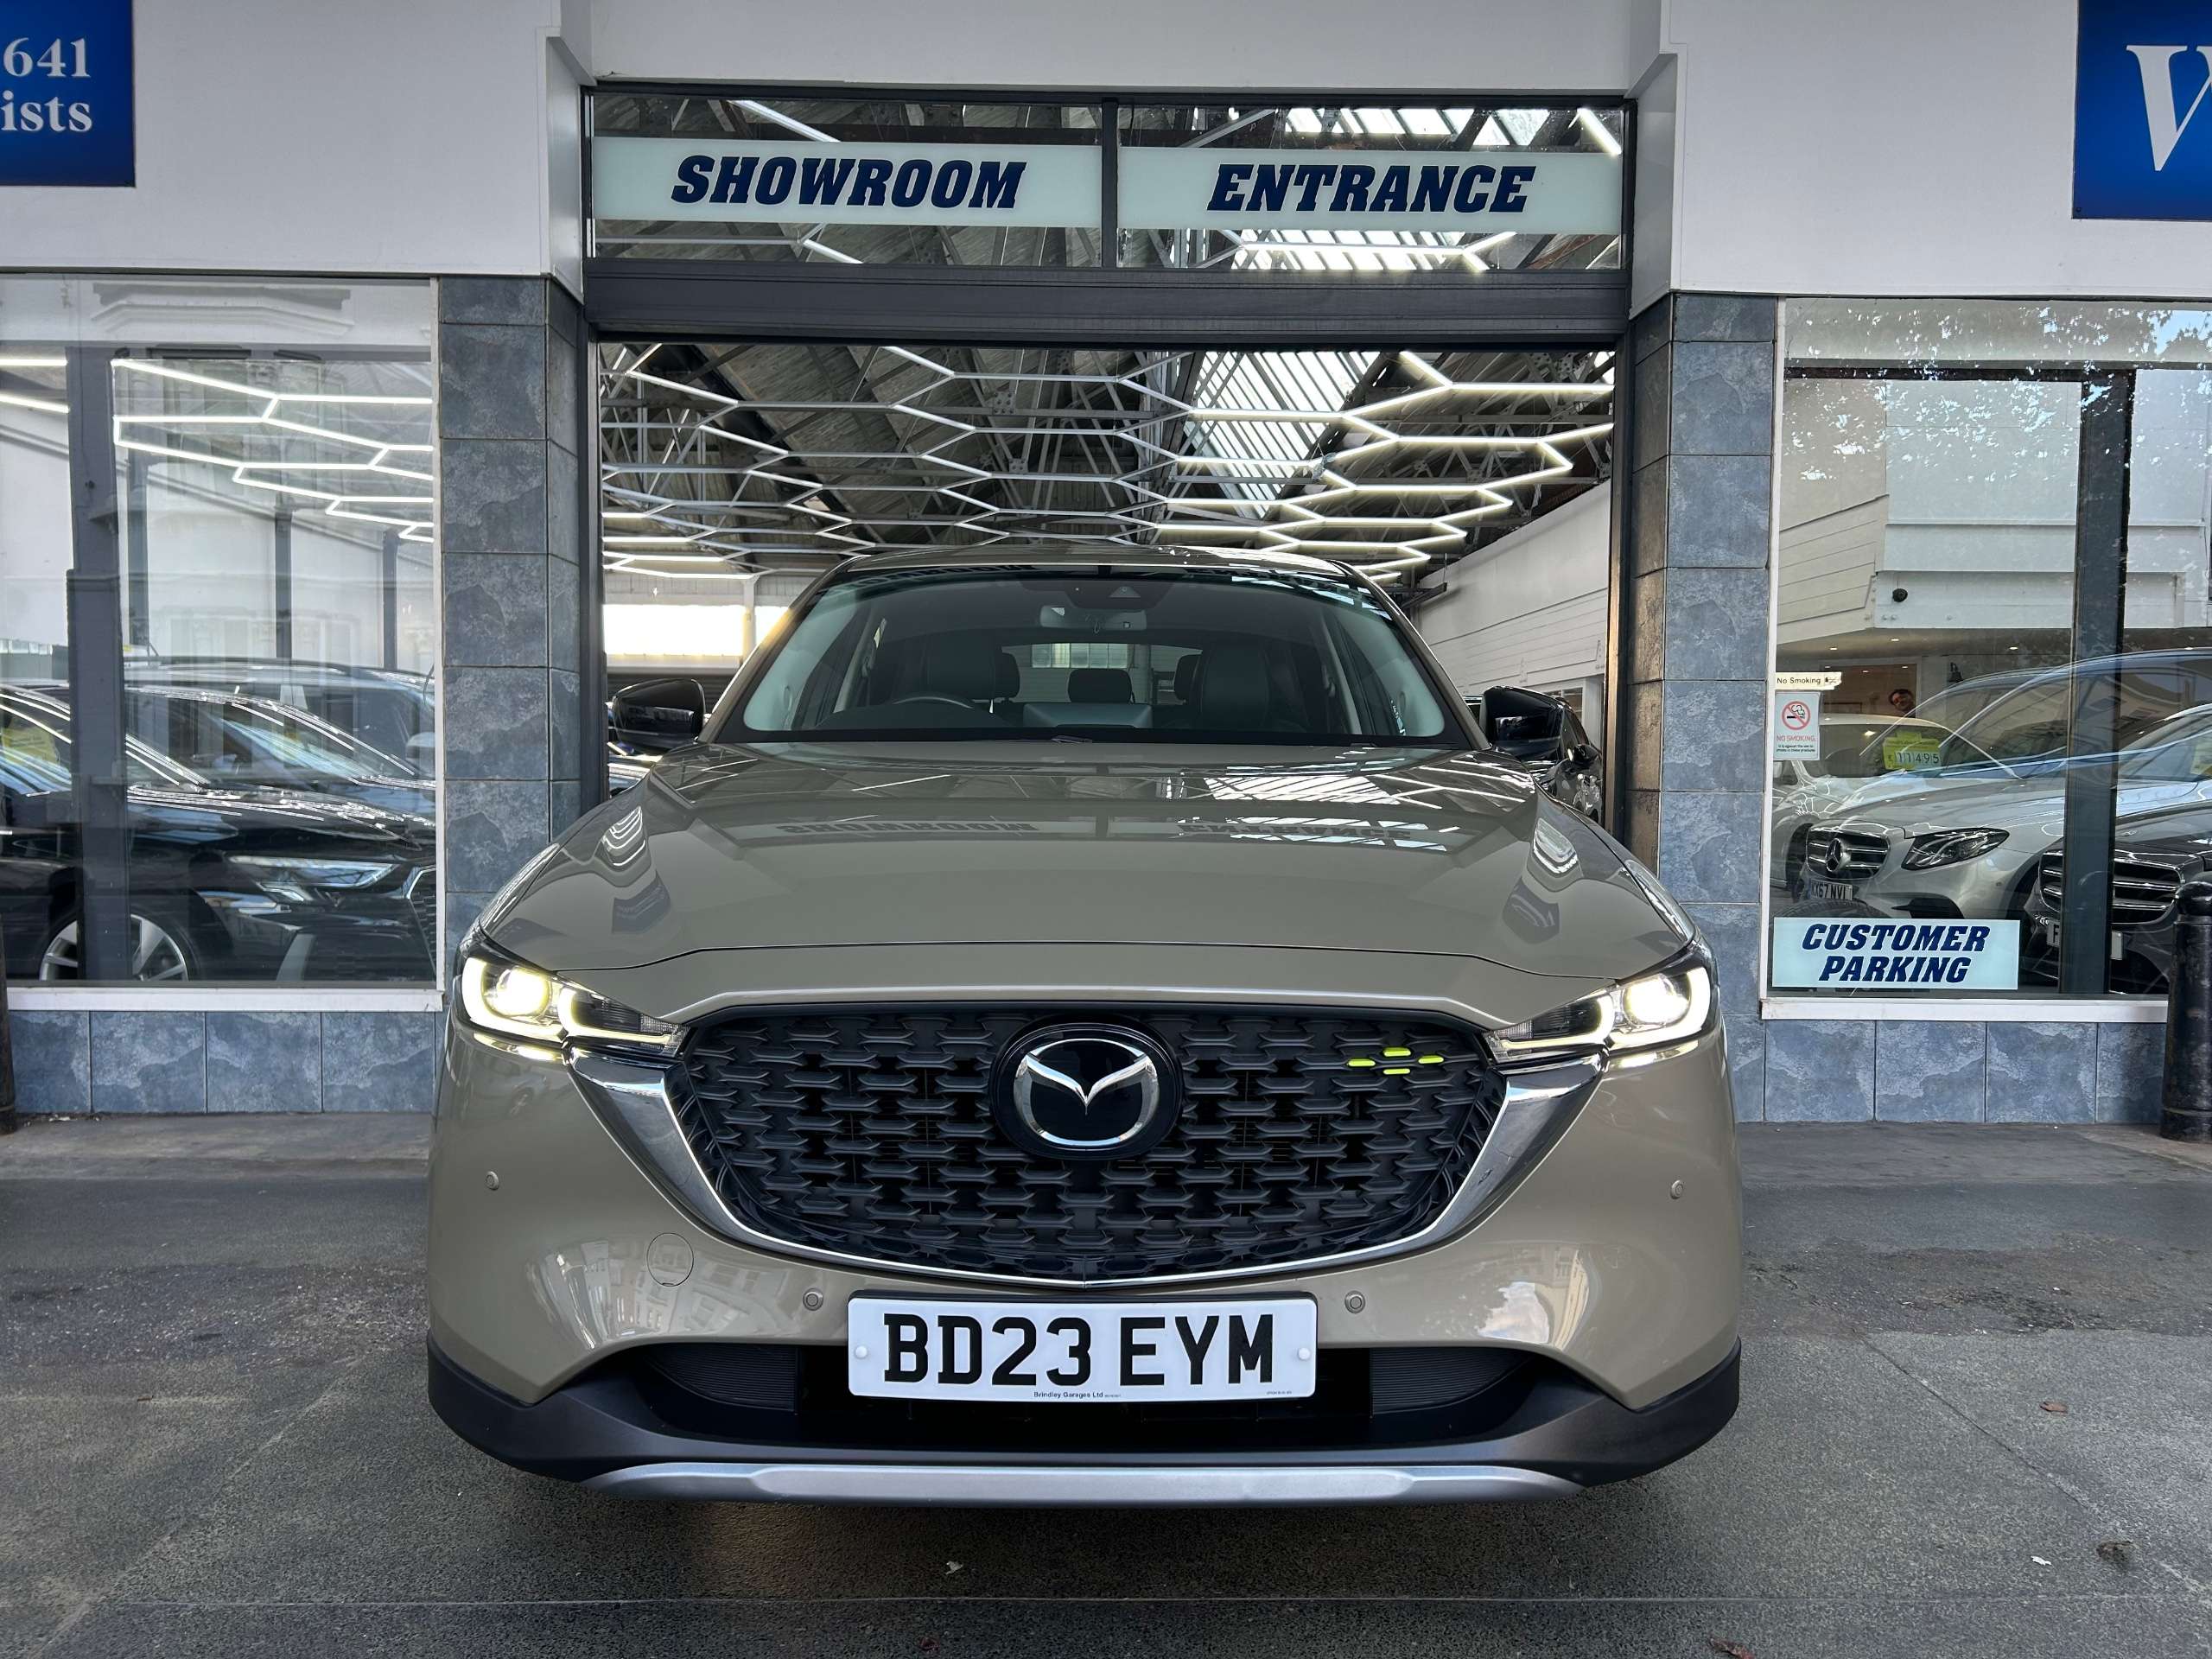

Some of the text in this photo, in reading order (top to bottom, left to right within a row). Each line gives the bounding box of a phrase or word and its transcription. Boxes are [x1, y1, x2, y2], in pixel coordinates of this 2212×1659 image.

[3, 37, 91, 77] 641
[1, 90, 92, 132] ists
[671, 155, 1536, 213] SHOWROOM ENTRANCE
[1802, 924, 1990, 951] CUSTOMER
[1818, 956, 1971, 982] PARKING
[883, 1313, 1274, 1386] BD23 EYM
